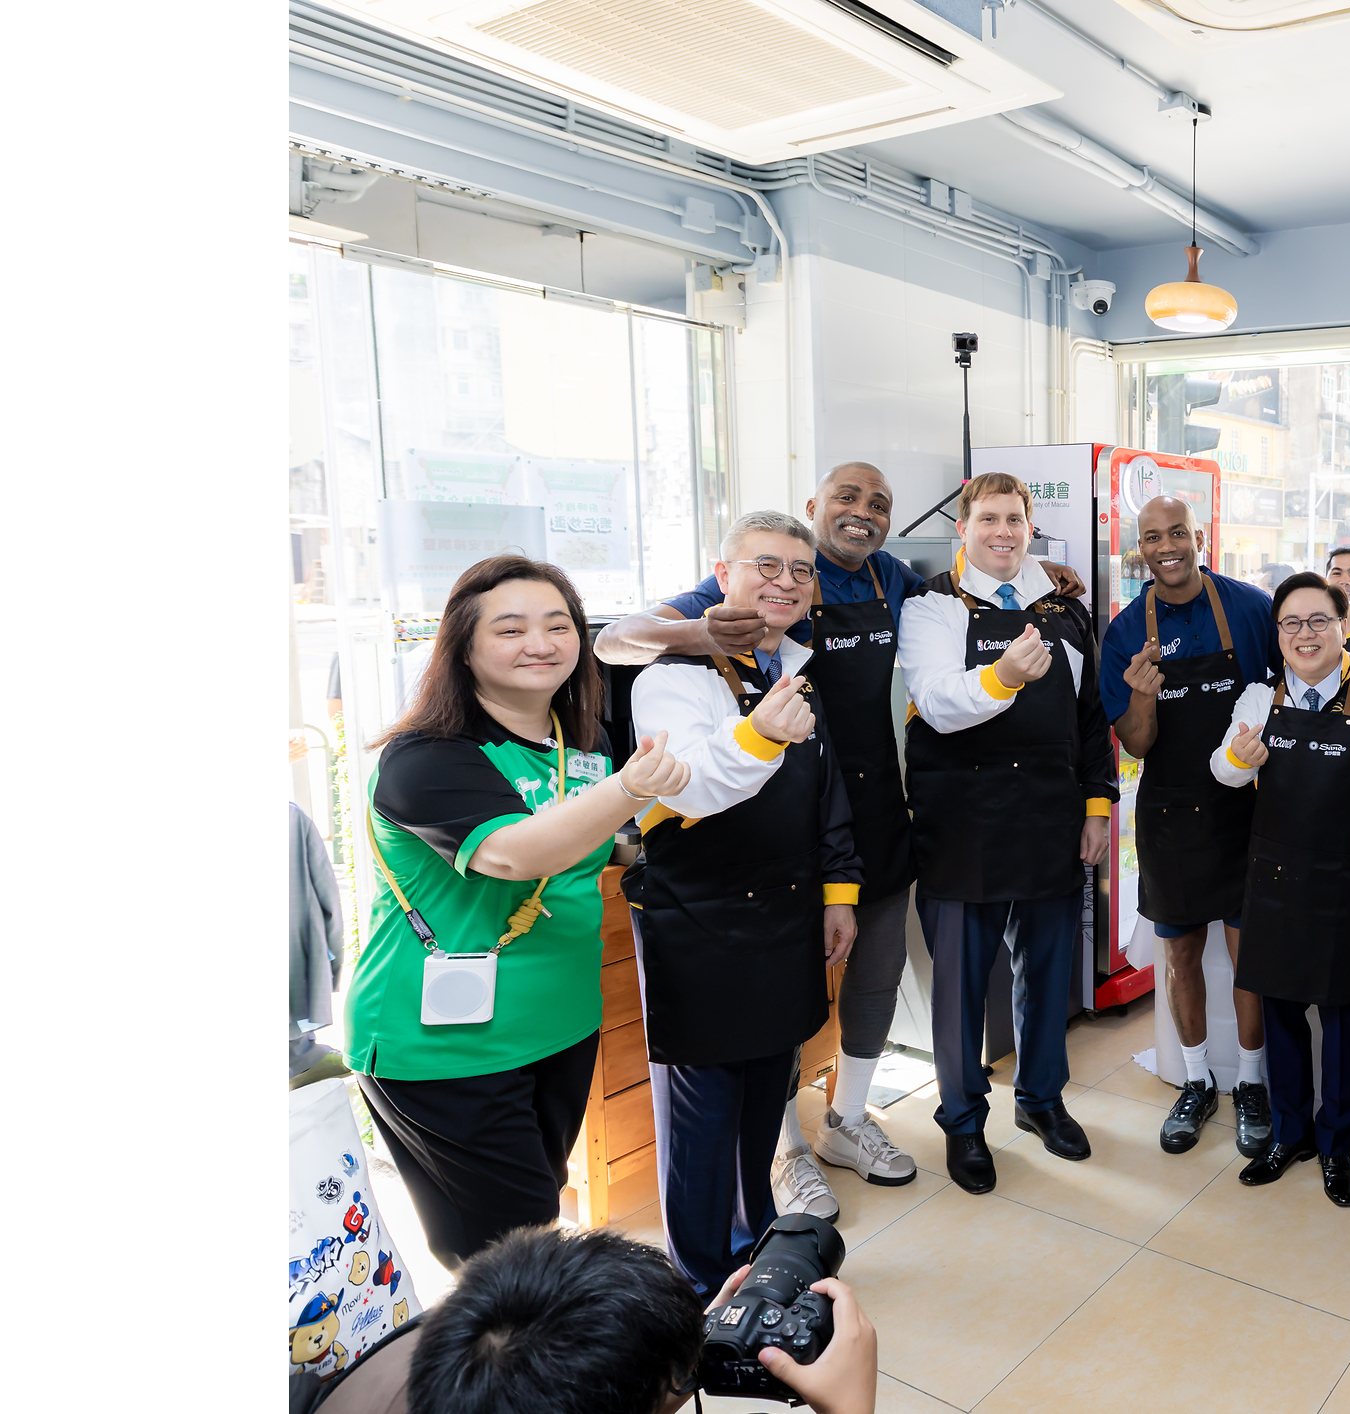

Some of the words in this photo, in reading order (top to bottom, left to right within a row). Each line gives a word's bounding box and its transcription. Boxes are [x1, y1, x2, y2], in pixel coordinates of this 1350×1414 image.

[1024, 481, 1070, 500] 扶康會
[832, 635, 861, 650] Cares
[983, 640, 1011, 651] Cares
[1162, 687, 1189, 700] Cares
